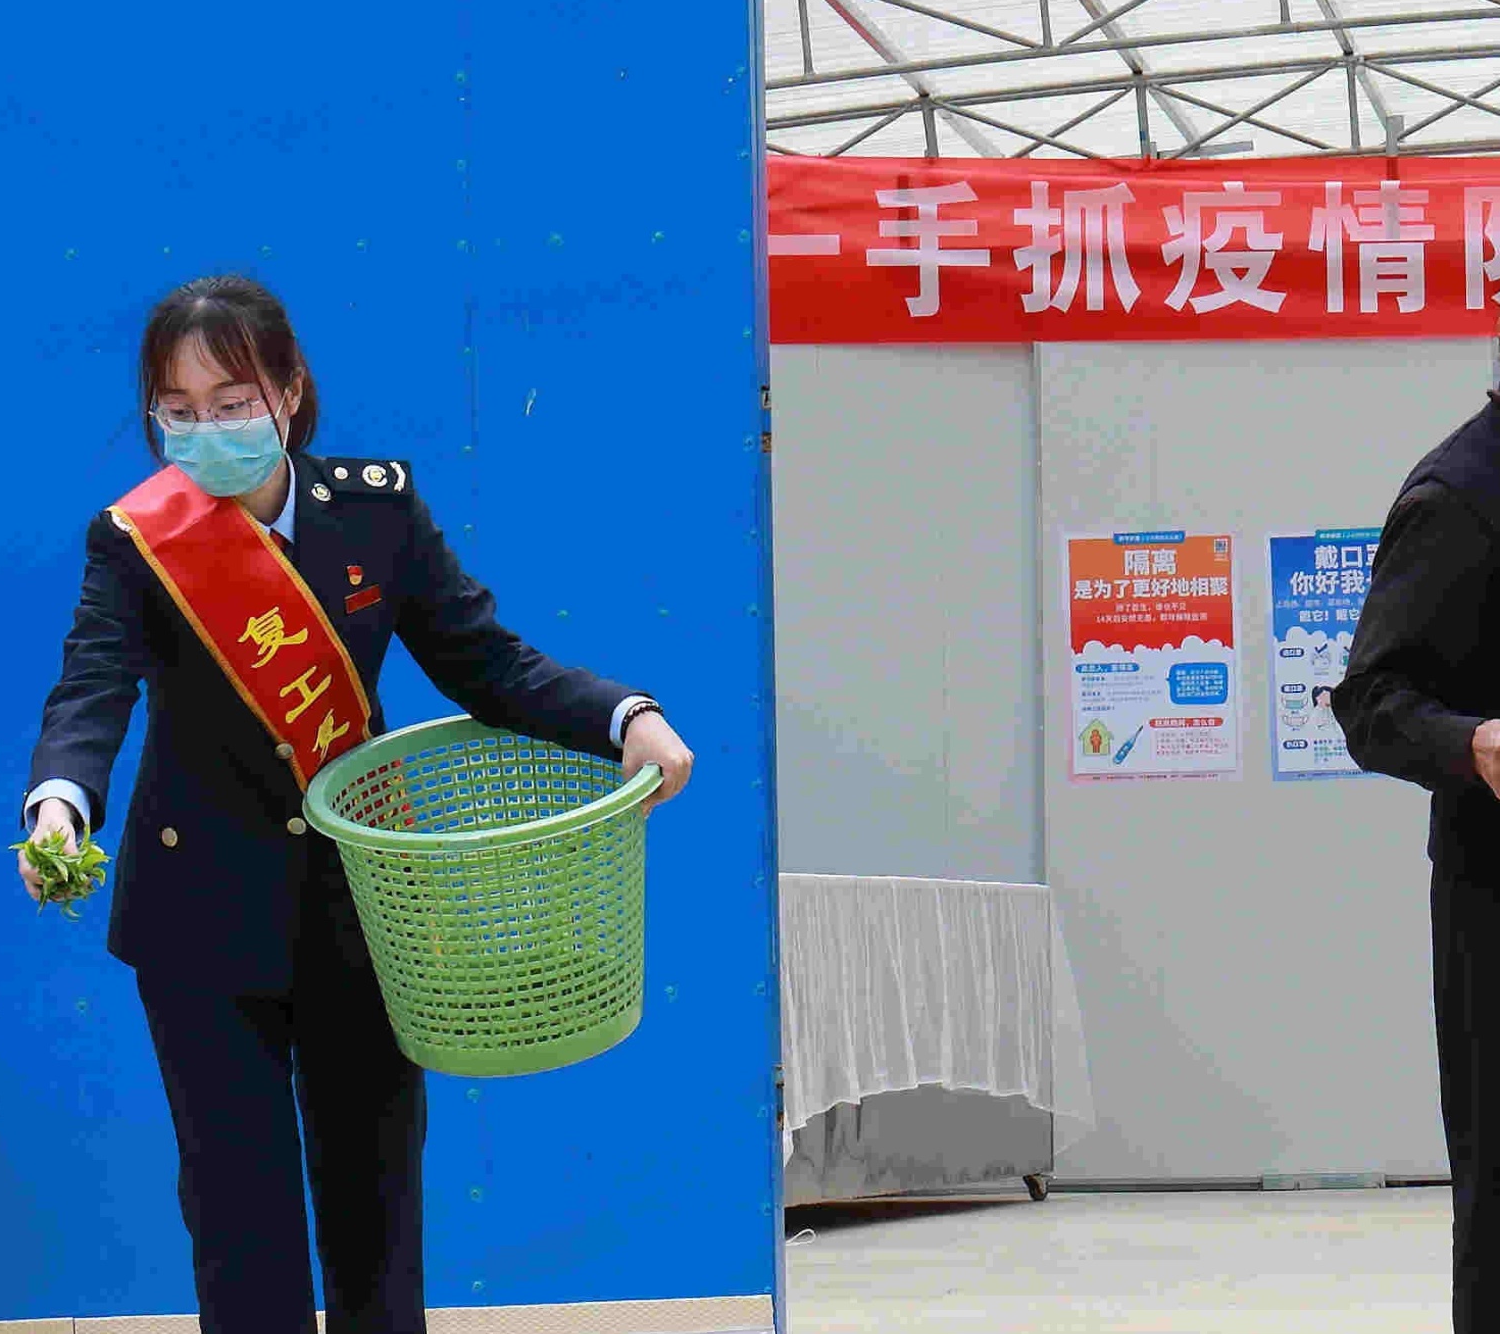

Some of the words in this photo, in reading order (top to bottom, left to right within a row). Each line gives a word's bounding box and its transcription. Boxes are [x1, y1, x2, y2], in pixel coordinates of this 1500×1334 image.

[1123, 548, 1178, 576] 隔离
[1074, 576, 1230, 600] 是为了更好地相聚
[1289, 569, 1372, 596] 你好我
